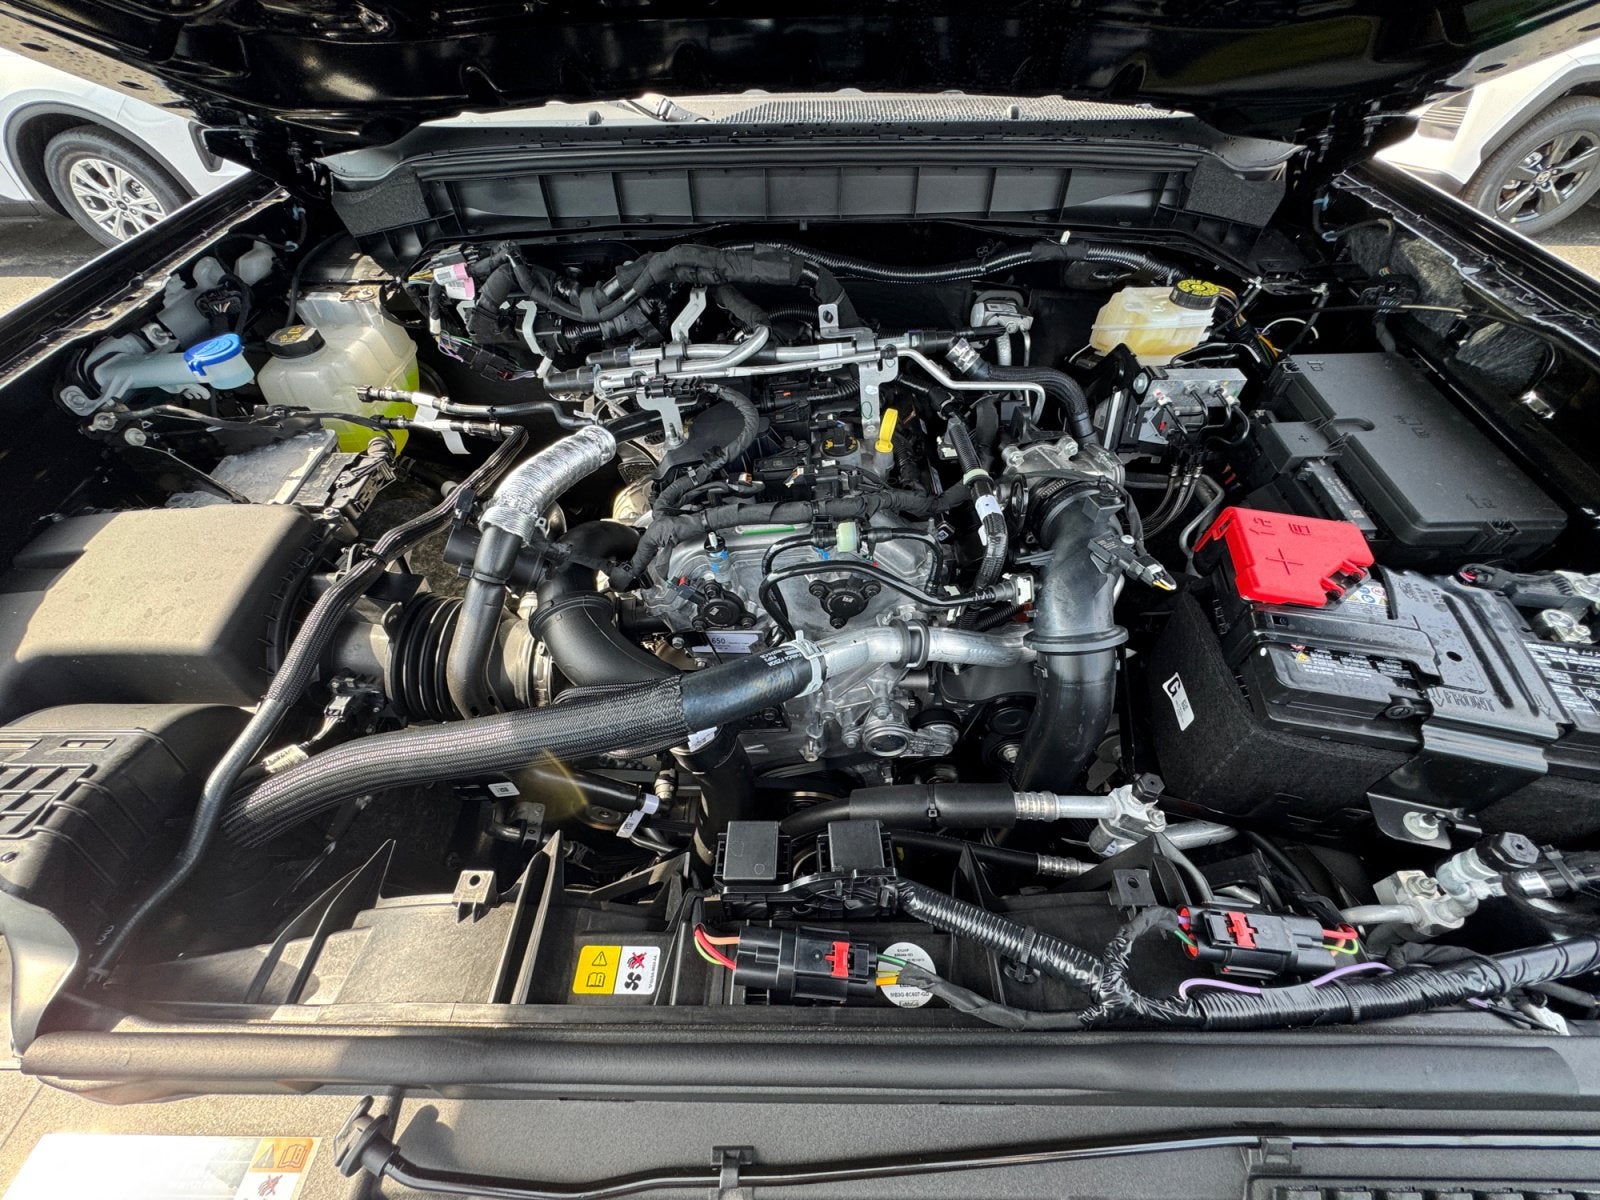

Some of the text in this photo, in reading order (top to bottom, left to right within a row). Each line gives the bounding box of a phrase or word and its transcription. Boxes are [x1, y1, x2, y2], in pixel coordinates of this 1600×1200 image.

[711, 637, 726, 645] 650
[1166, 676, 1181, 697] G
[1443, 690, 1495, 712] FRONT
